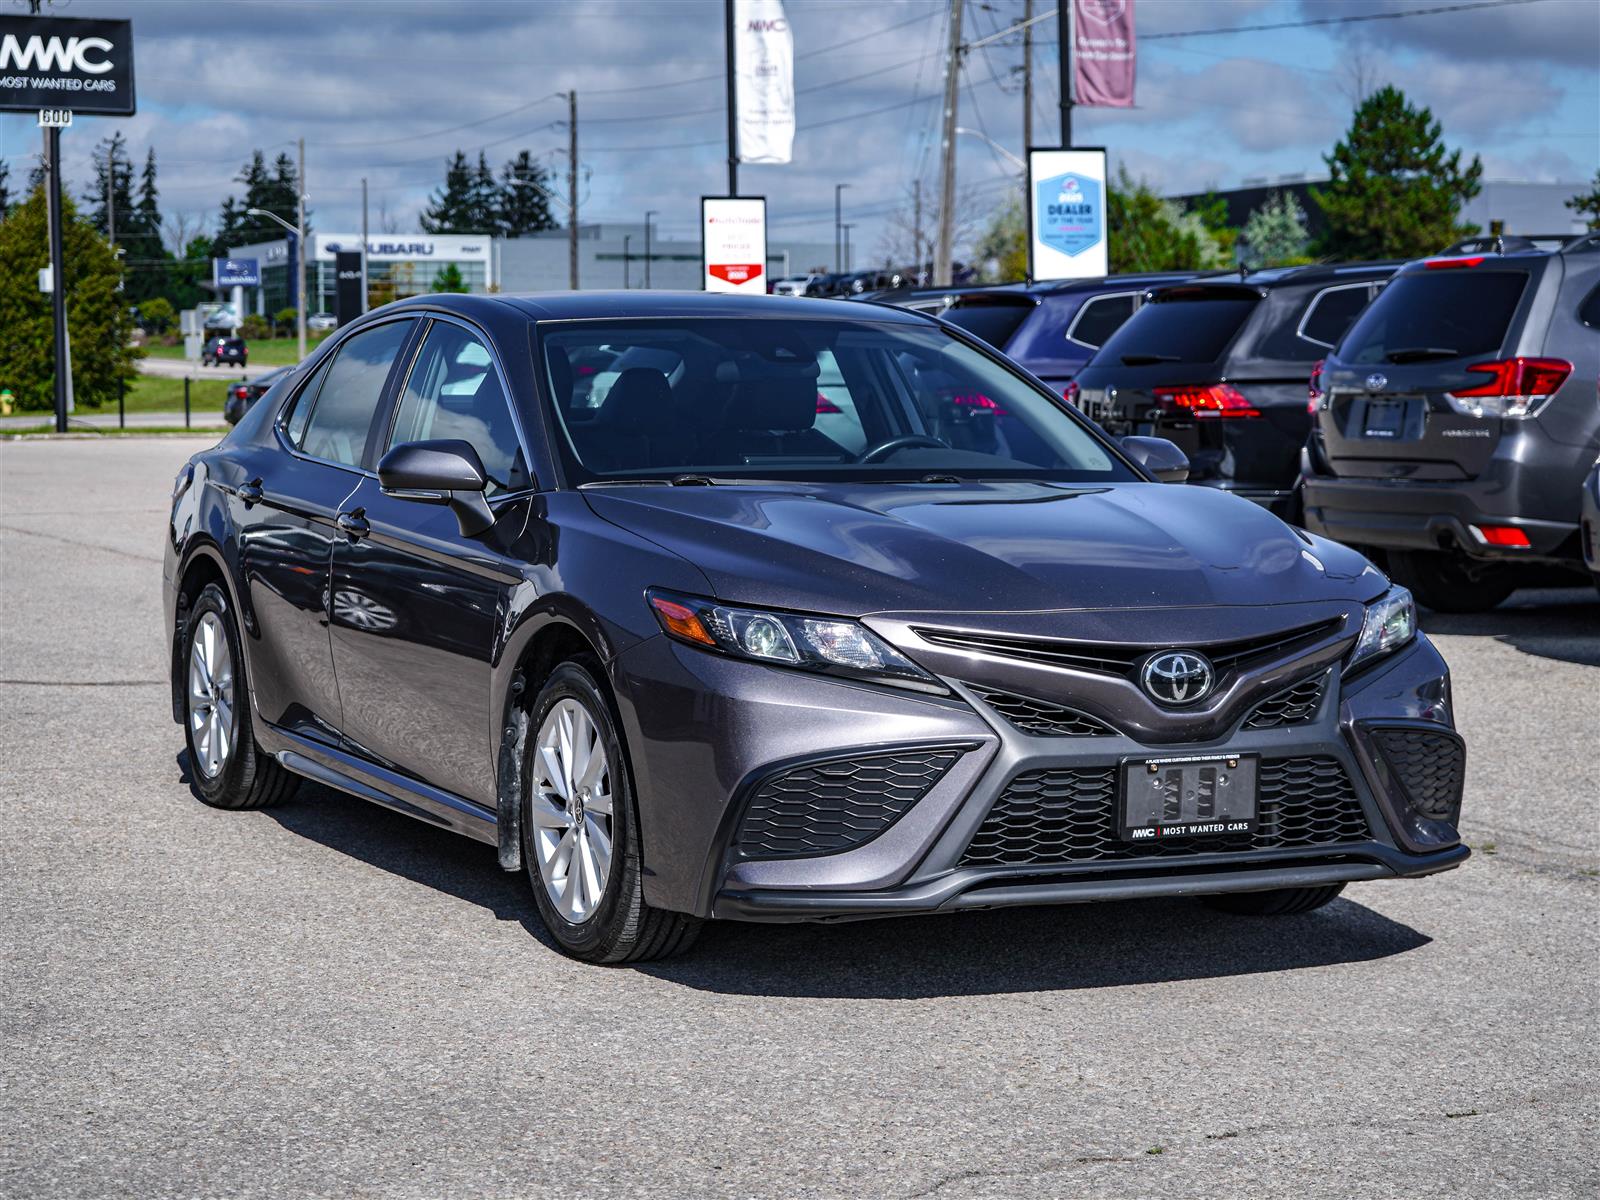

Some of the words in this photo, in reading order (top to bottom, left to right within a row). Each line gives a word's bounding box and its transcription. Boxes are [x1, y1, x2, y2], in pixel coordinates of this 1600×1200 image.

[30, 77, 82, 91] WANTED
[83, 79, 116, 92] CARS
[43, 110, 70, 123] 600
[1047, 204, 1092, 216] DEALER
[1163, 826, 1187, 836] MOST
[1190, 823, 1225, 834] WANTED
[1227, 822, 1249, 831] CARS
